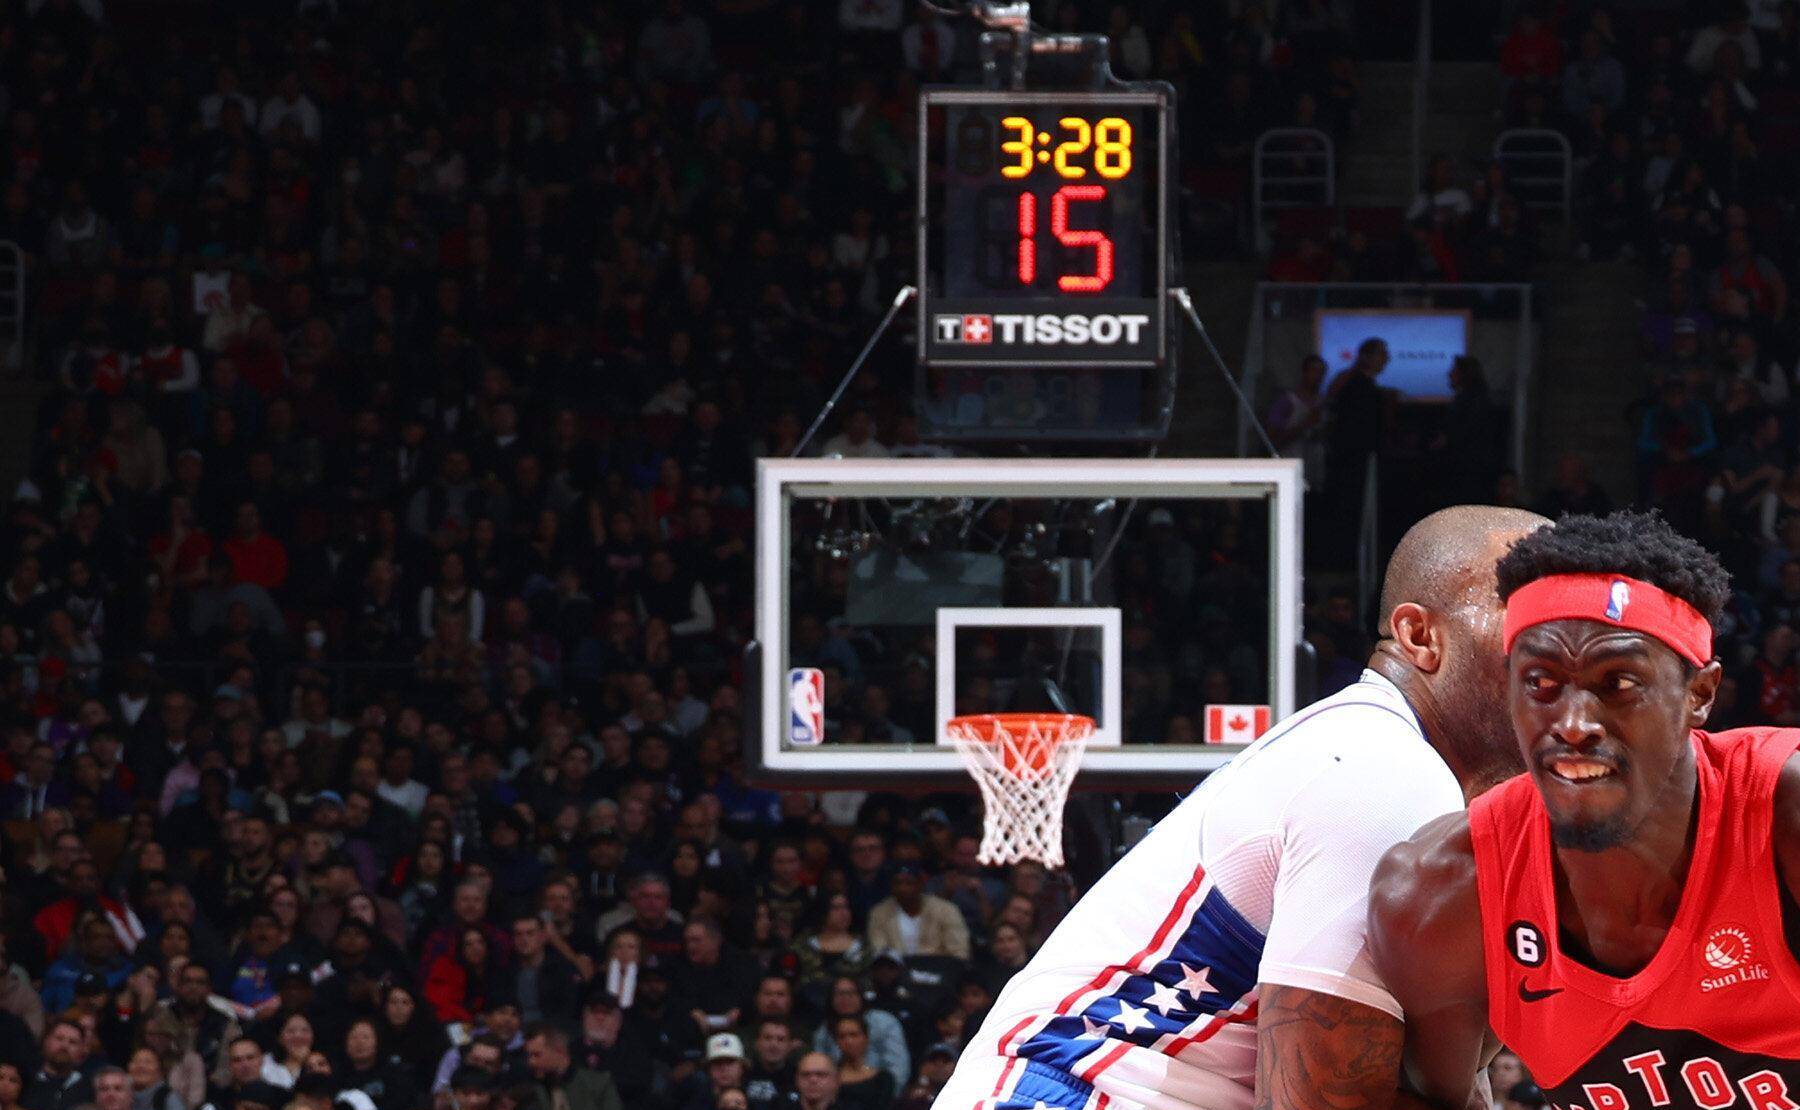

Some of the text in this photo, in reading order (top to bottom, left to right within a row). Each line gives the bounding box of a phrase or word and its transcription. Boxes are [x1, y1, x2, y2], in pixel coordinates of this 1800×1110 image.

[1001, 116, 1134, 180] 3:28
[1017, 184, 1115, 293] 15
[995, 313, 1149, 346] TISSOT
[1515, 925, 1539, 964] 6
[1700, 963, 1770, 993] Sun Life
